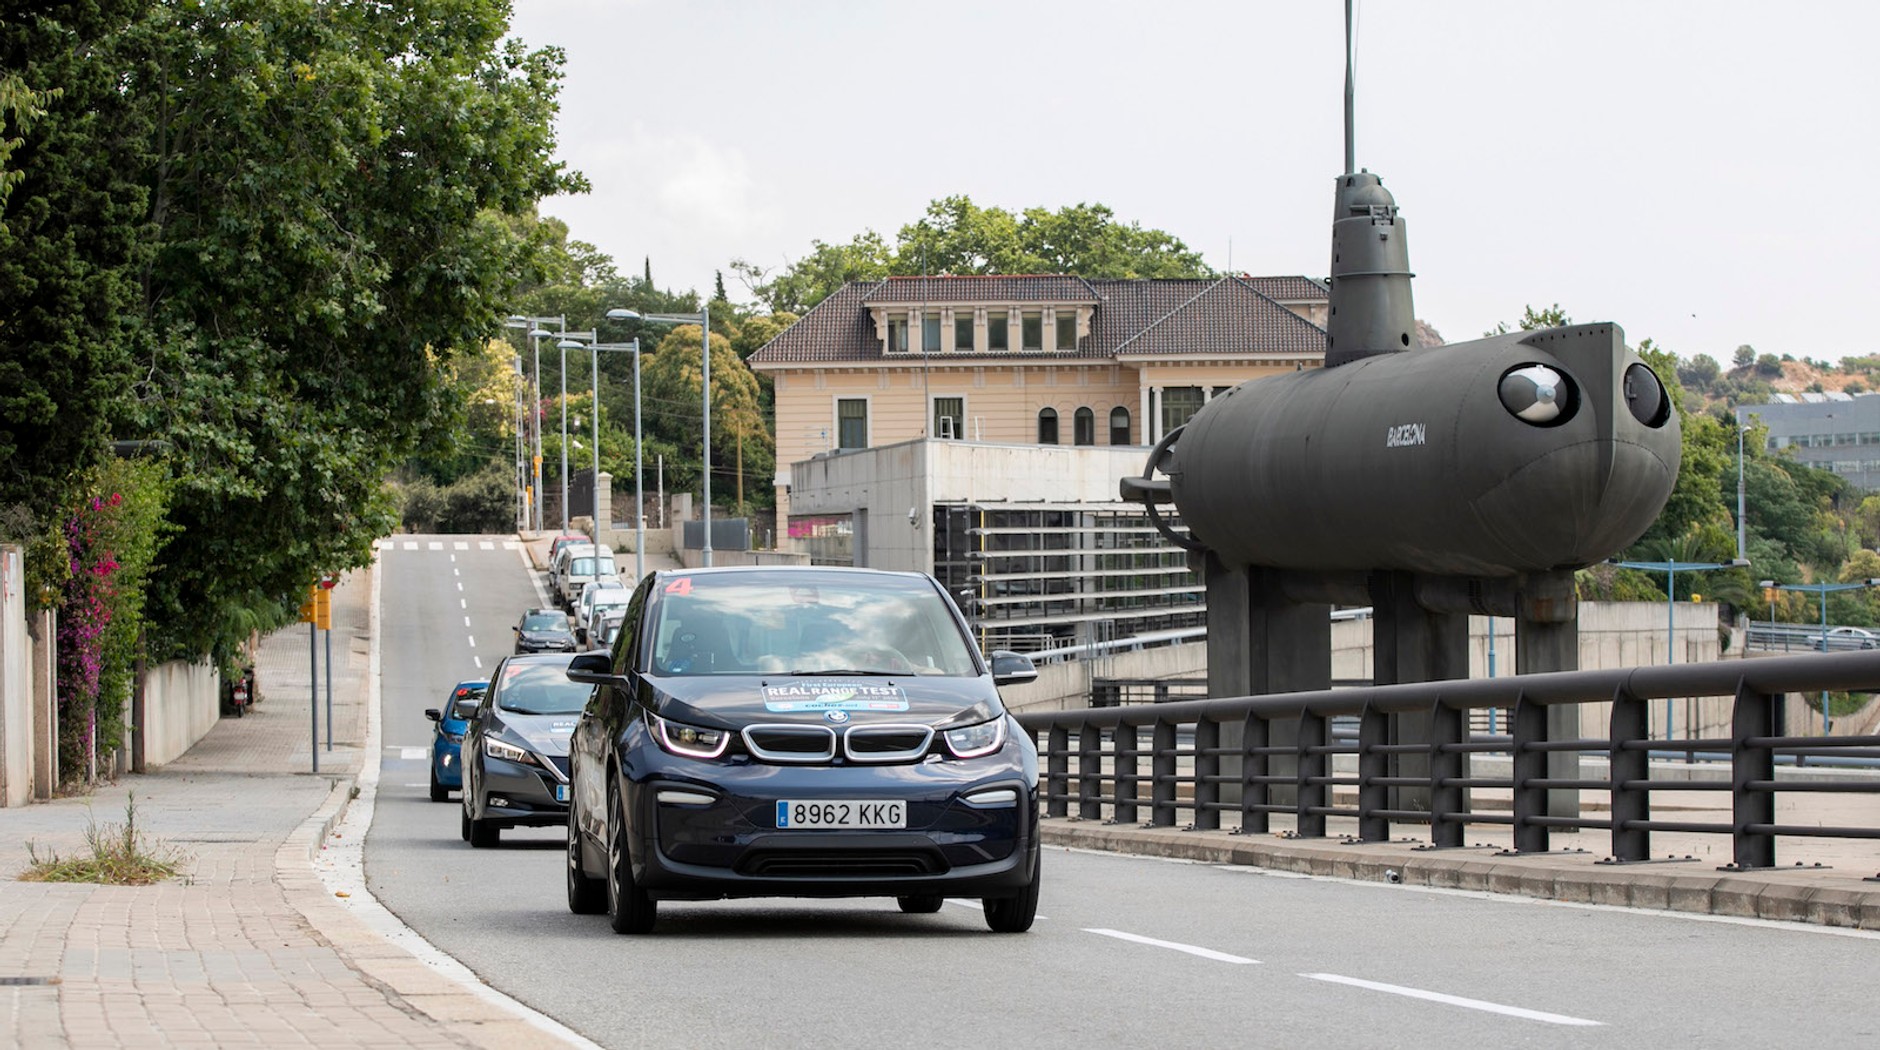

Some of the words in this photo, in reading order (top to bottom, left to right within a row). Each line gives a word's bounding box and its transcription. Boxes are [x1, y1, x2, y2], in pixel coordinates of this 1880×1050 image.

[665, 577, 693, 596] 4
[767, 686, 811, 697] REAL
[811, 686, 859, 696] RANGE
[859, 686, 898, 696] TEST
[794, 804, 850, 825] 8962
[859, 804, 901, 825] KKG
